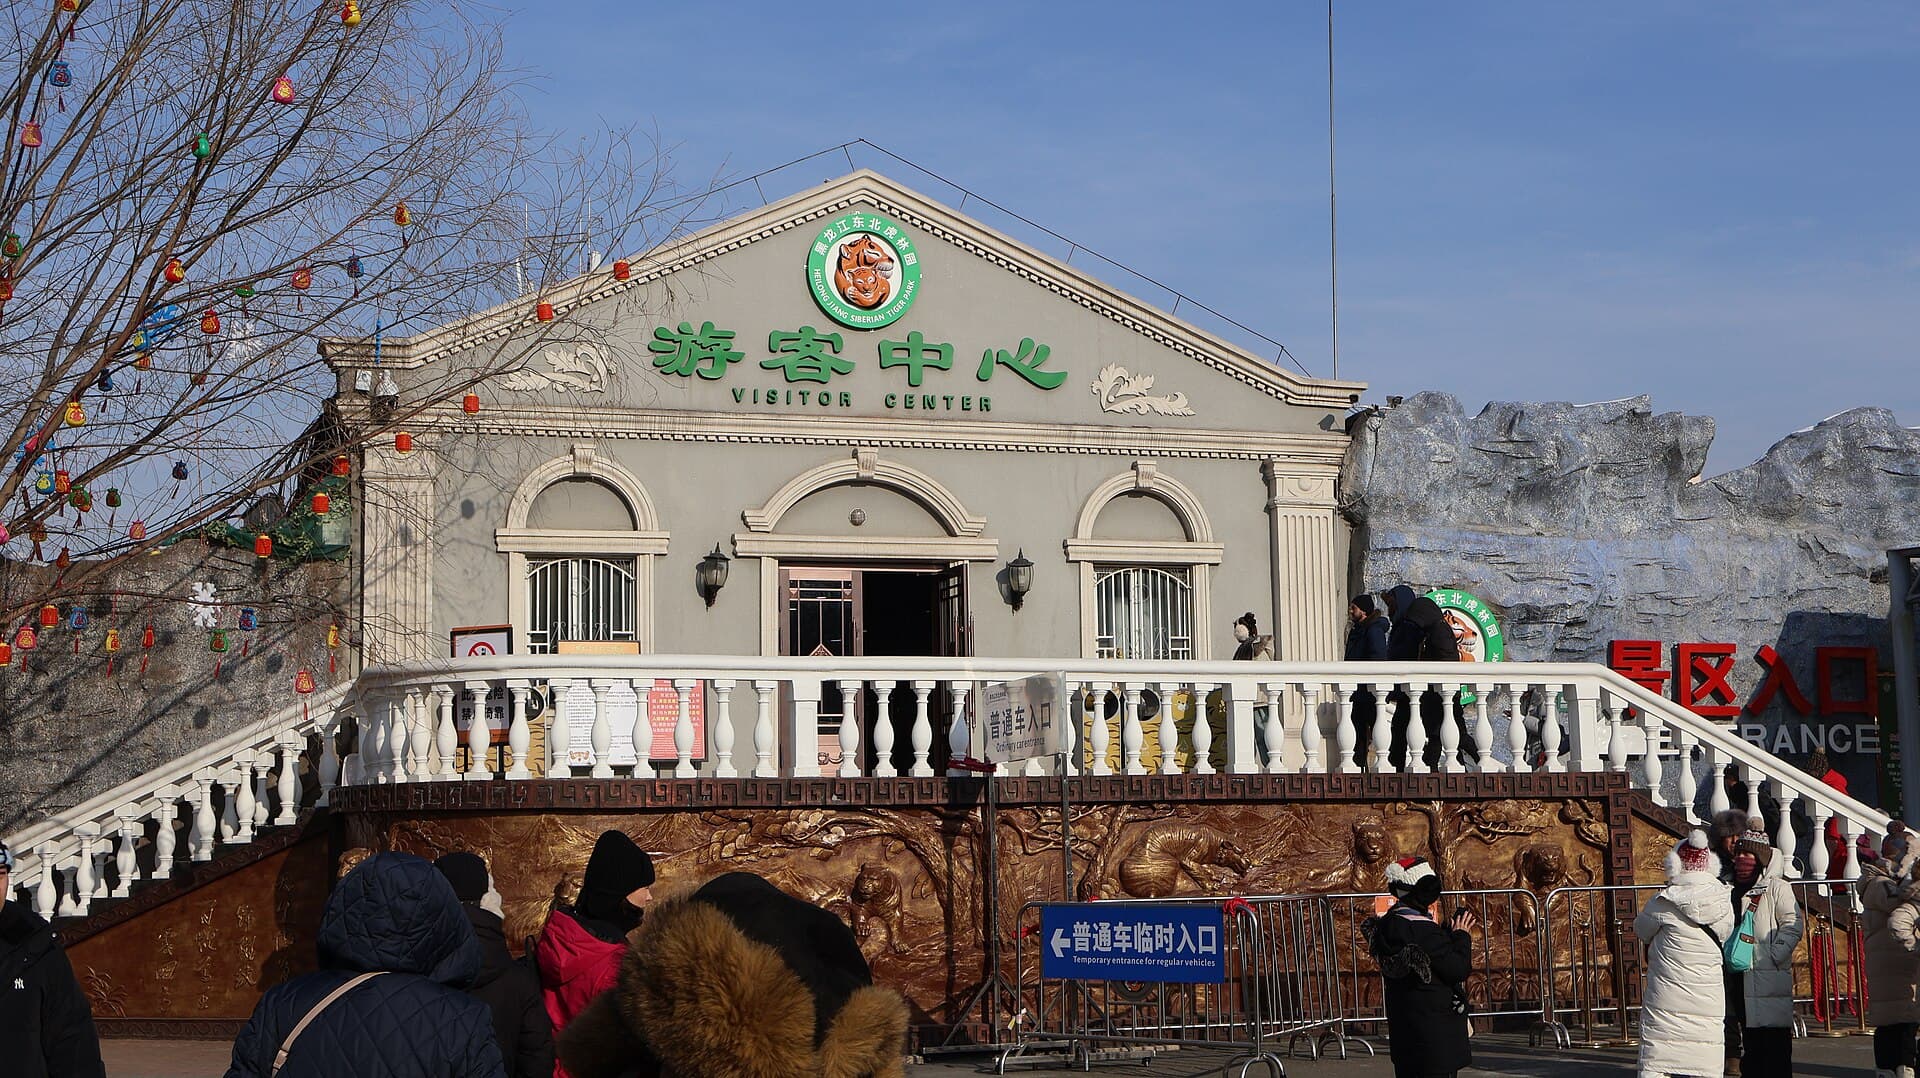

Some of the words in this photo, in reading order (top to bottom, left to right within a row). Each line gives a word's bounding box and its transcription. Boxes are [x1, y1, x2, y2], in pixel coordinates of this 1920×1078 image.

[815, 216, 917, 266] 黑龙江东北虎林园
[813, 268, 829, 302] HEILONG
[828, 300, 849, 319] JIANG
[850, 313, 885, 323] SIBERIAN
[886, 299, 906, 318] TIGER
[904, 280, 916, 302] PARK
[647, 320, 1068, 390] 游客中心
[732, 387, 852, 407] VISITOR
[885, 393, 993, 412] CENTER
[1609, 640, 1878, 718] 景区入口
[990, 703, 1051, 740] 普通车入口
[1652, 723, 1881, 755] ERANCE
[1072, 921, 1217, 954] 普通车临时入口
[1073, 955, 1111, 966] Temporary
[1112, 957, 1144, 965] entrance
[1144, 957, 1156, 965] for
[1157, 958, 1184, 967] regular
[1185, 958, 1216, 967] vehicles
